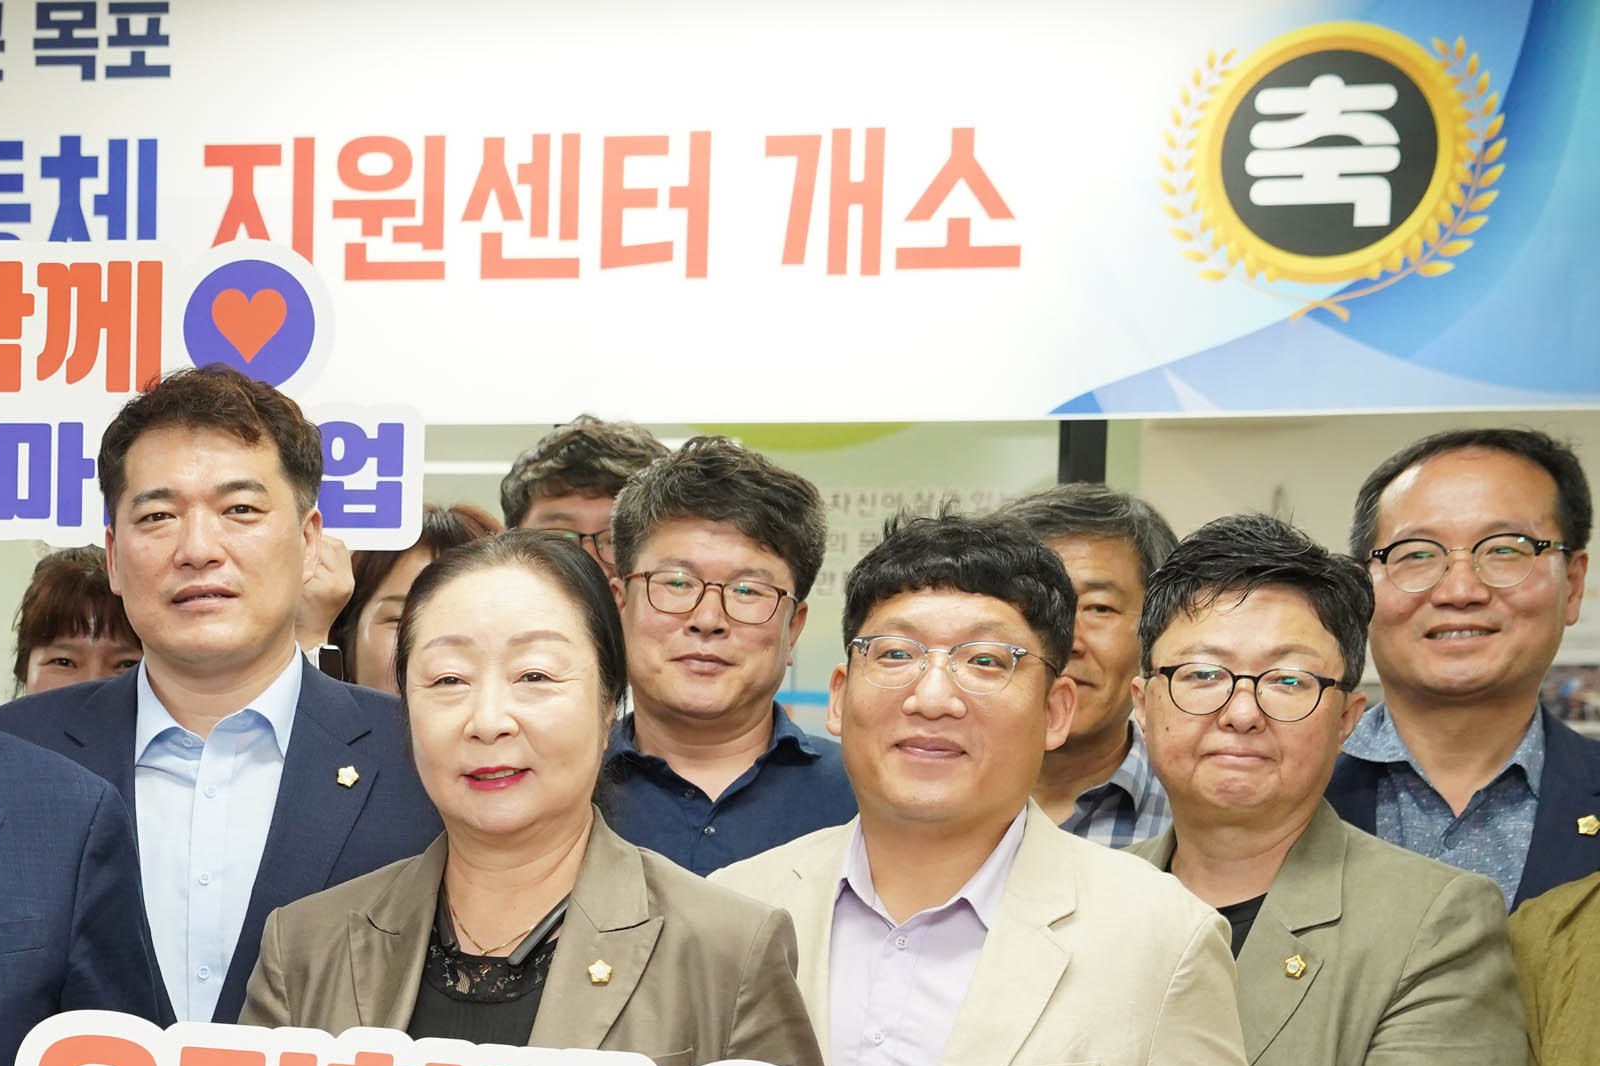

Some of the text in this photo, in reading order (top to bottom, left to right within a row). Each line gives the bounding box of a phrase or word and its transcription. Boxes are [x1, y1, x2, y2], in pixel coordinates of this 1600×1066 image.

[33, 1, 171, 81] 목포
[204, 132, 711, 281] 지원센터
[766, 127, 1021, 276] 개소
[1245, 74, 1401, 227] 축
